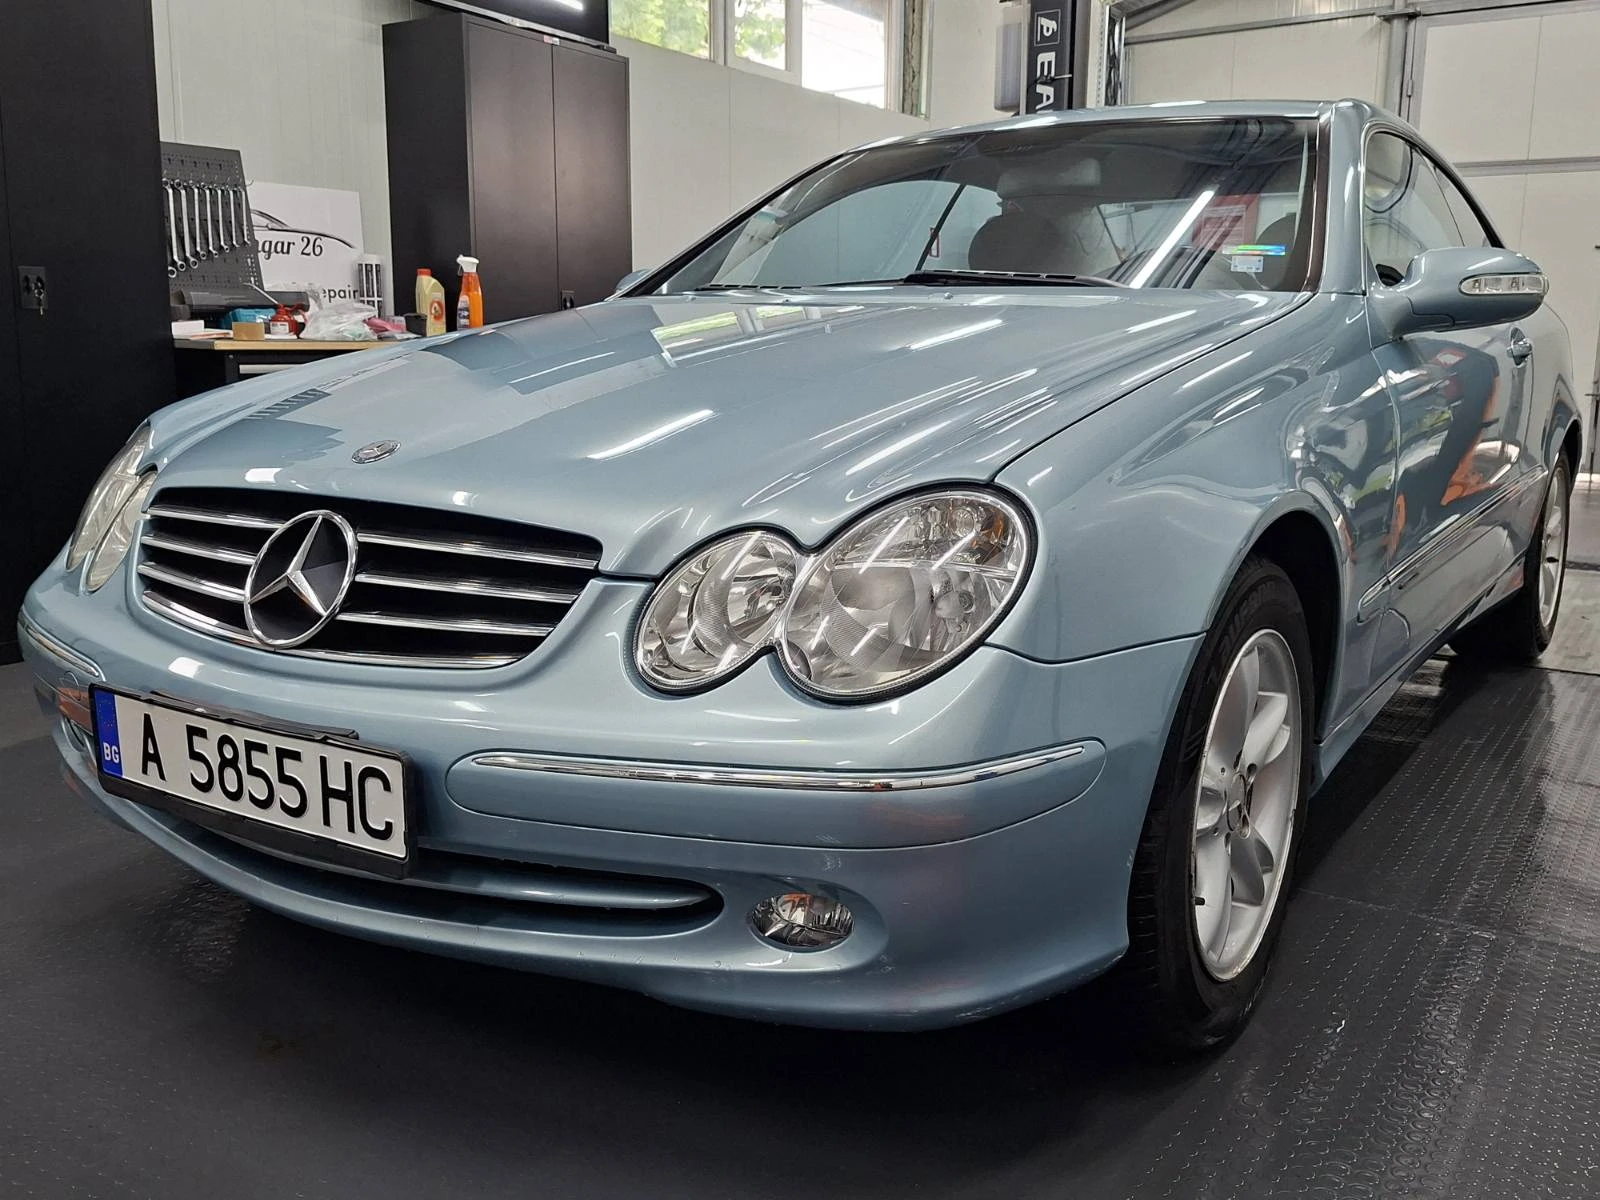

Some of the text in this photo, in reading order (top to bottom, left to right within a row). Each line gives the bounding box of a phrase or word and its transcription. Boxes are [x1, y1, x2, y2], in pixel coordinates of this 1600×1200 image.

[1035, 51, 1056, 114] EA
[258, 236, 323, 260] gar 26
[103, 742, 120, 764] BG
[141, 712, 394, 841] A 5855 HC
